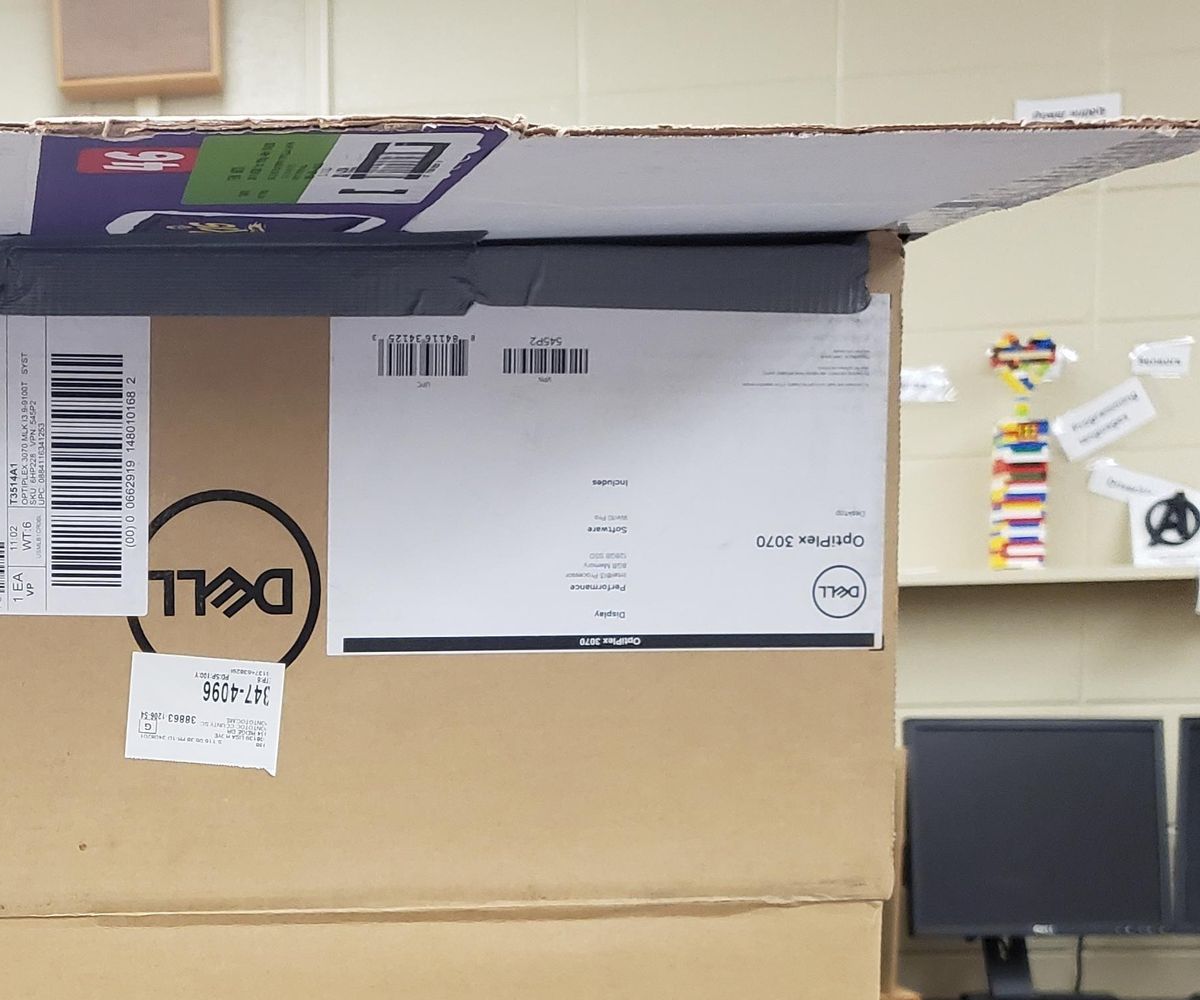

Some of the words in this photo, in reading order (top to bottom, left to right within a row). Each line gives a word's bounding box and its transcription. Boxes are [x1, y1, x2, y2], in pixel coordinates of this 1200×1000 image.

[388, 334, 422, 344] 34125
[425, 334, 458, 344] 84116
[530, 336, 562, 346] 545P2
[20, 352, 28, 375] SYST
[126, 391, 136, 452] 148010168
[9, 463, 18, 504] T3514A1
[21, 464, 29, 505] OPTIPLEX
[126, 460, 136, 509] 0662919
[592, 479, 628, 487] Includes
[836, 509, 865, 518] Desktop
[588, 526, 627, 534] Software
[22, 522, 32, 551] WT:6
[126, 526, 136, 548] (00)
[756, 535, 794, 547] 3070
[799, 533, 865, 547] OptiPlex
[13, 573, 23, 591] EA
[570, 584, 626, 592] Performance
[27, 583, 34, 596] VP
[148, 567, 293, 618] DELL
[818, 586, 859, 598] DELL
[595, 610, 625, 619] Display
[580, 637, 600, 646] 3070
[603, 636, 641, 645] OptiPlex
[145, 722, 152, 731] G
